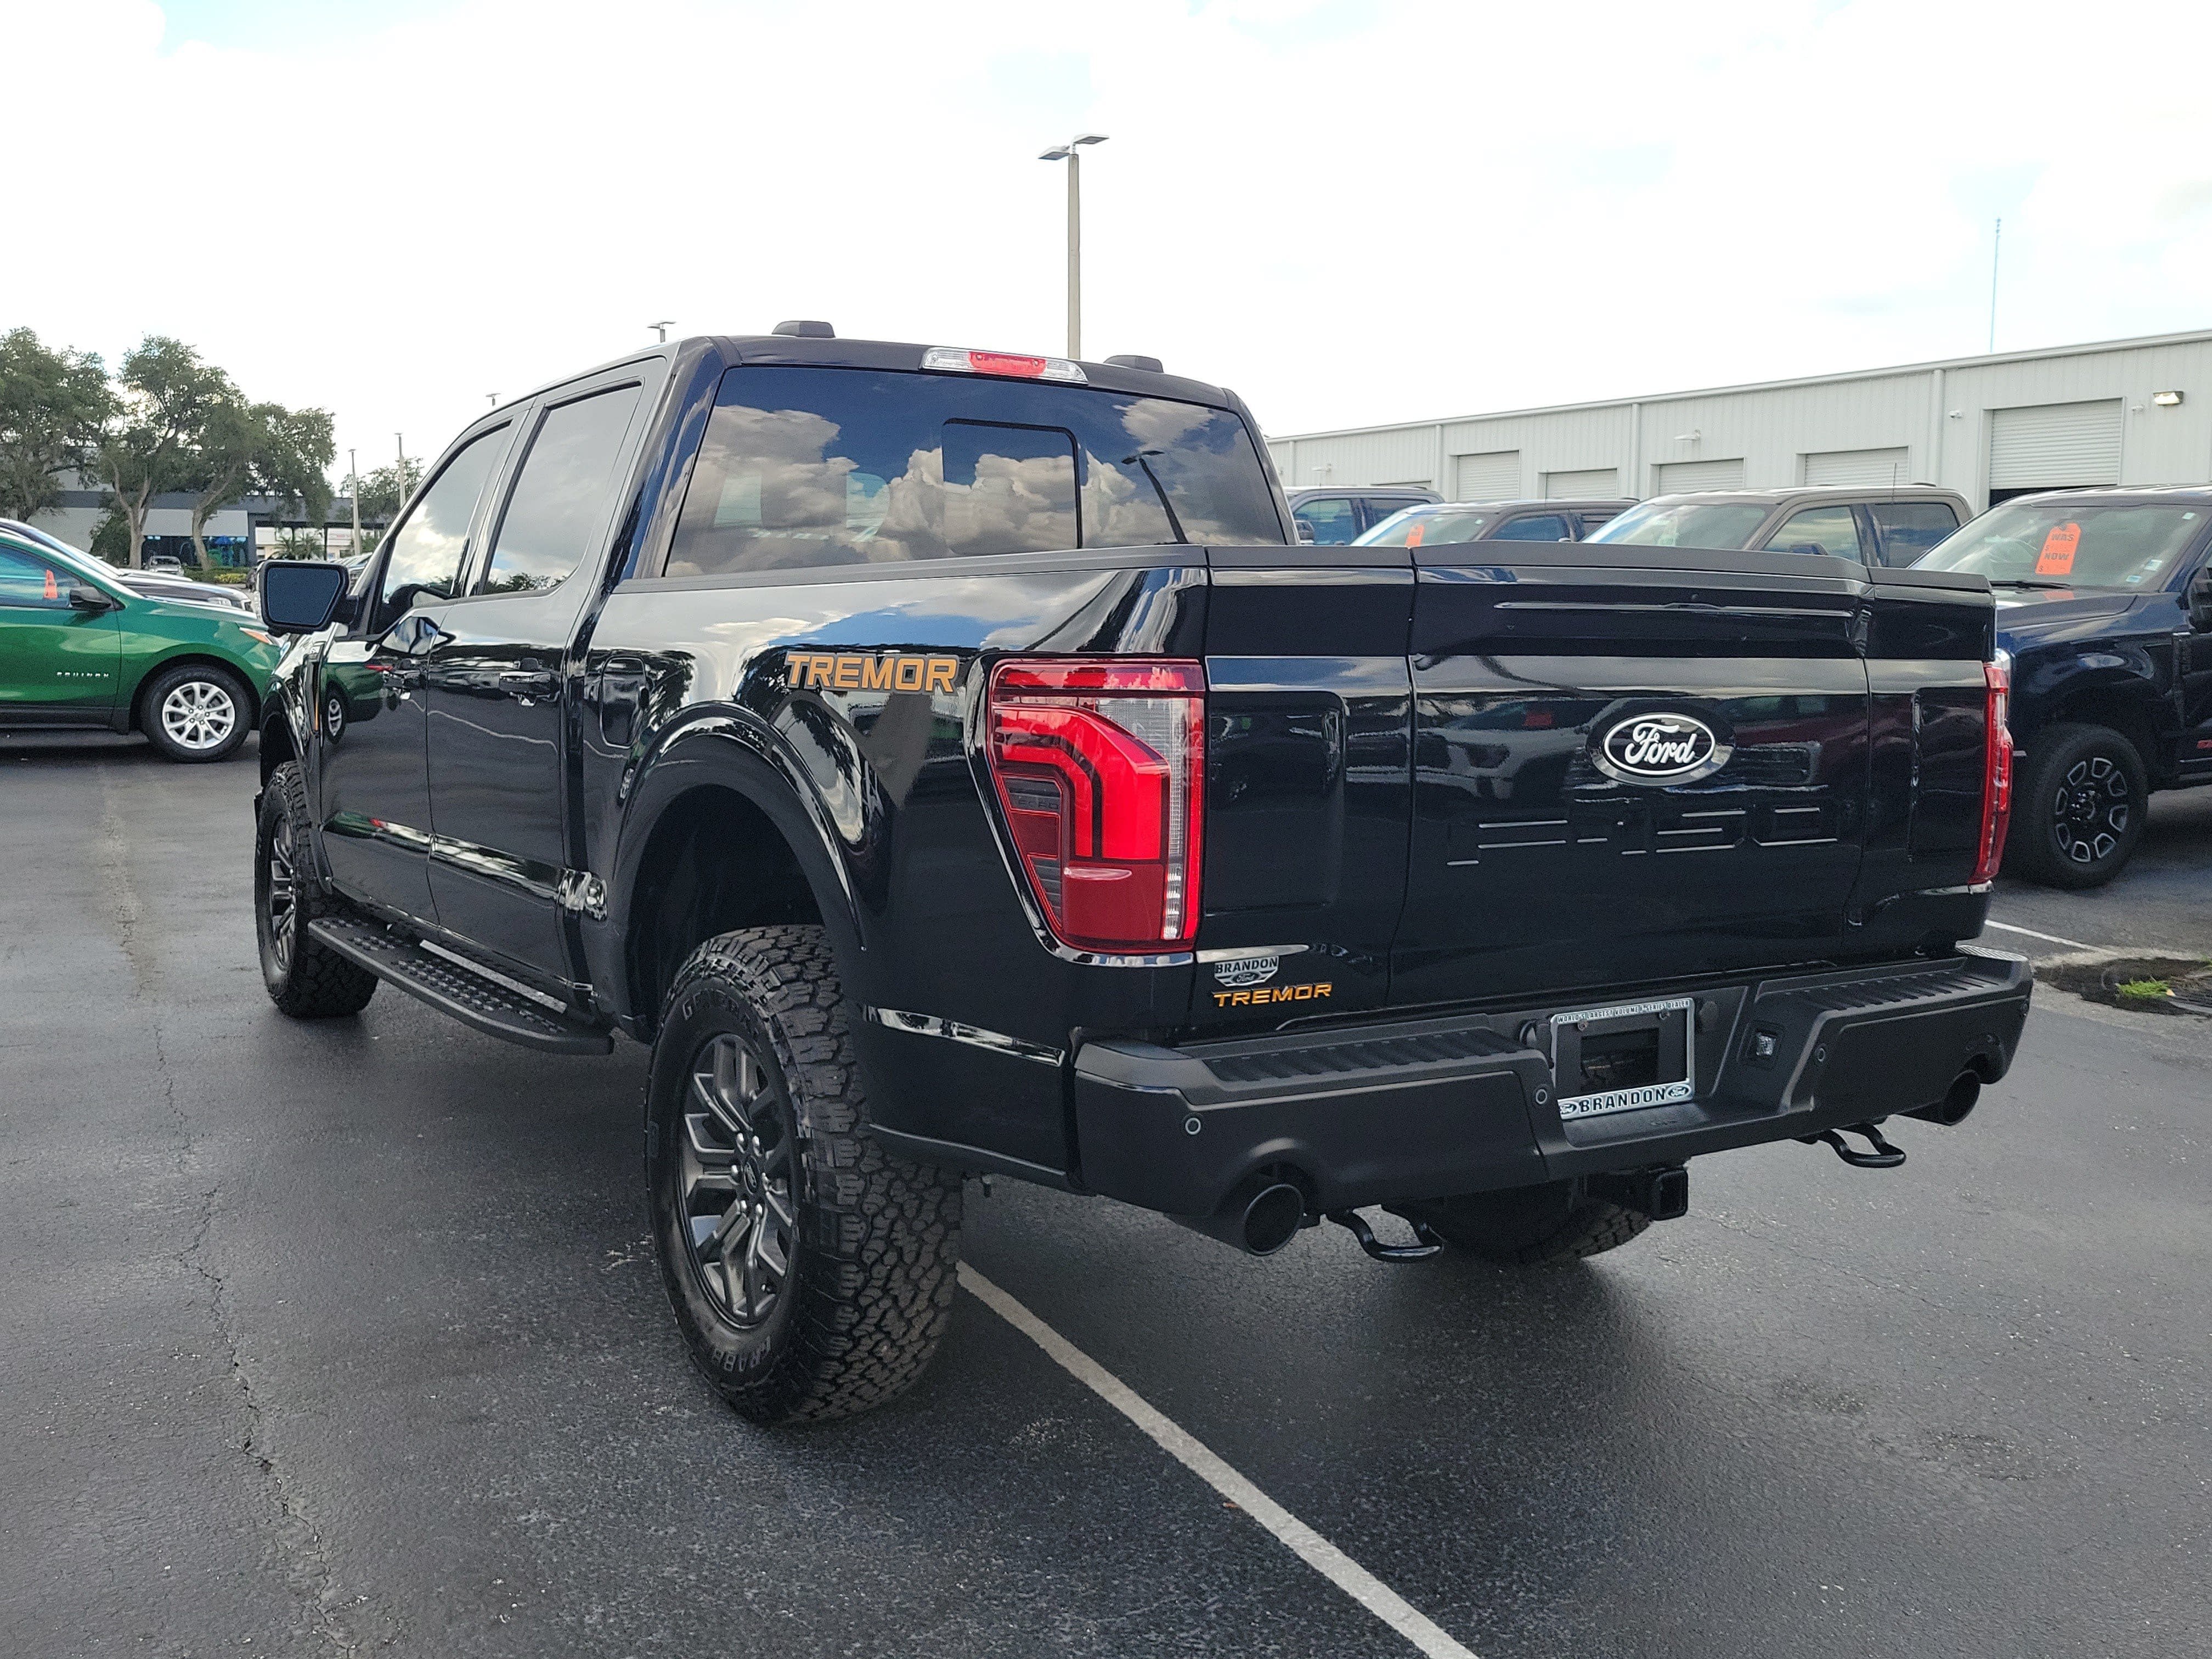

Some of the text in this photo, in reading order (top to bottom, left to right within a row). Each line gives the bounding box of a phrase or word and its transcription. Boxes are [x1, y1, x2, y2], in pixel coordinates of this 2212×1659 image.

[786, 653, 959, 694] TREMOR
[1624, 722, 1697, 764] Ford
[1214, 956, 1278, 974] BRANDON
[1212, 982, 1333, 1008] TREMOR
[1587, 1009, 1612, 1019] LARGEST
[1614, 1006, 1638, 1015] VOLUME
[1579, 1087, 1666, 1113] BRANDON
